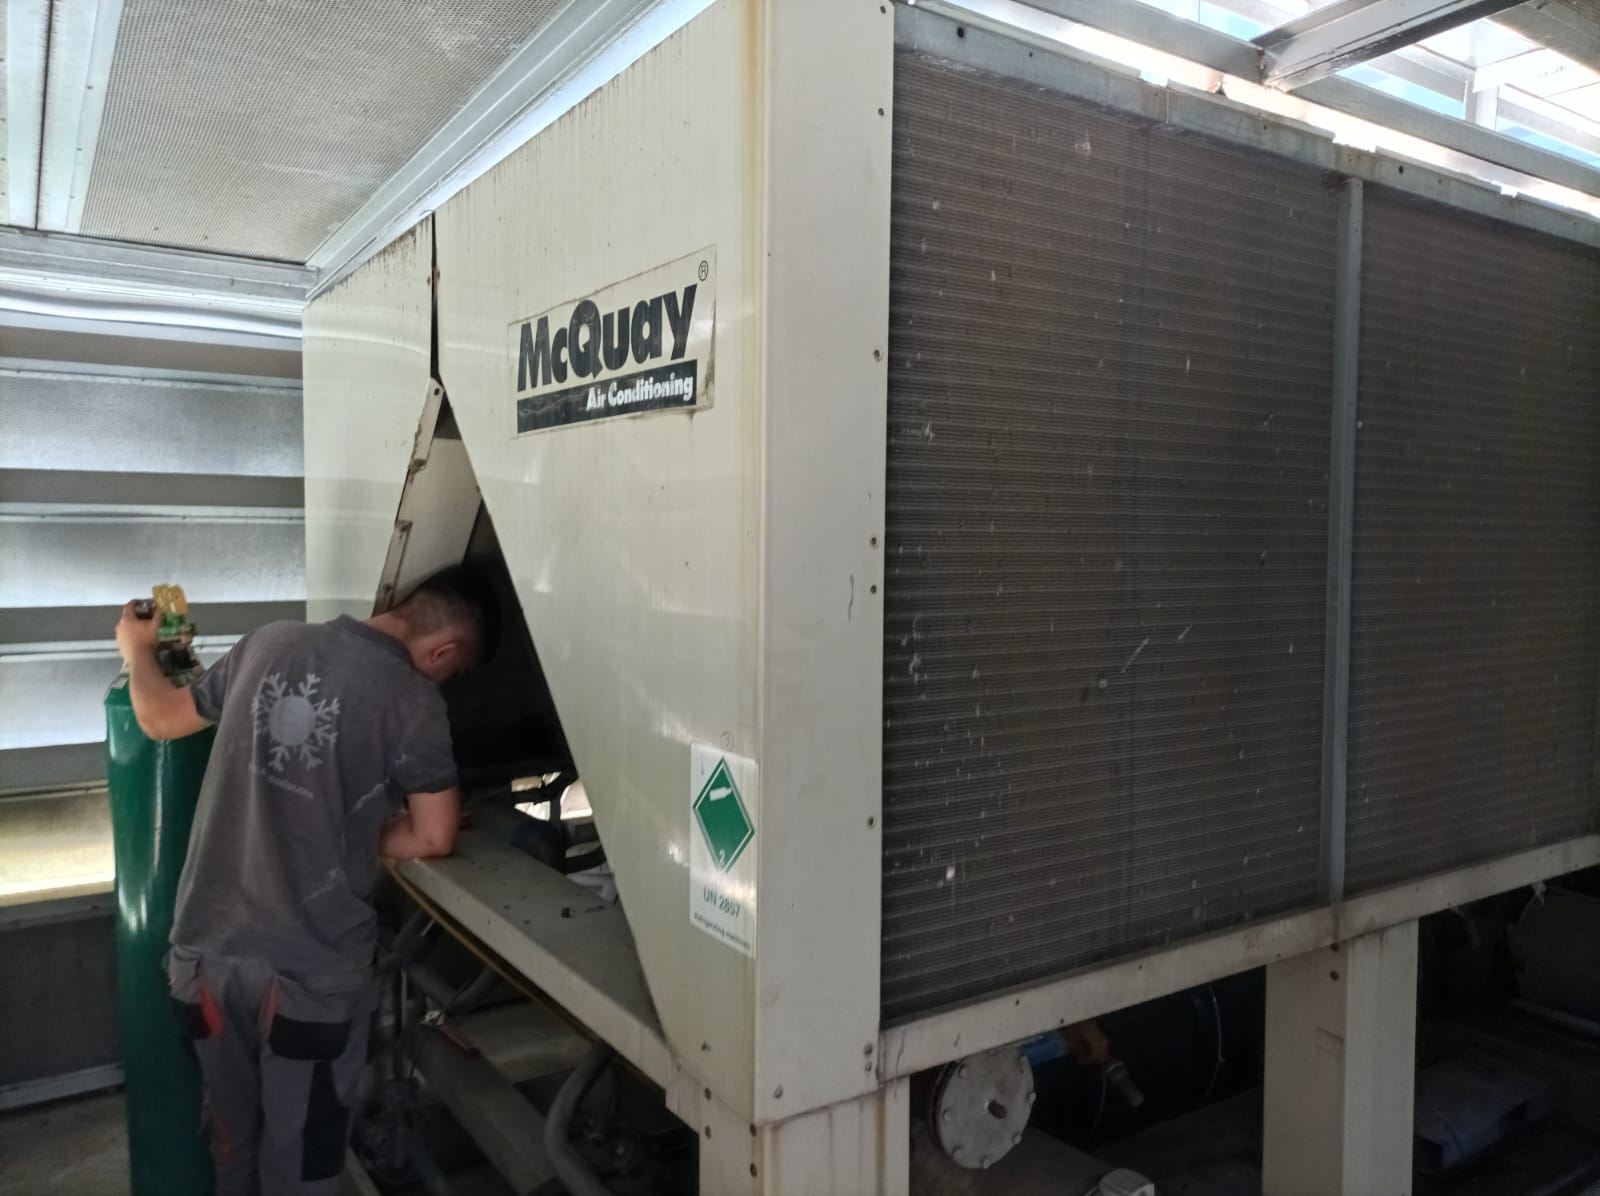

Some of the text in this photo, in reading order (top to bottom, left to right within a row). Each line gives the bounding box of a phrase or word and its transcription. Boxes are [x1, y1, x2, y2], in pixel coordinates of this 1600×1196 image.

[517, 283, 698, 393] McQuay
[586, 372, 694, 412] Air Conditioning
[703, 886, 741, 918] UN 2857
